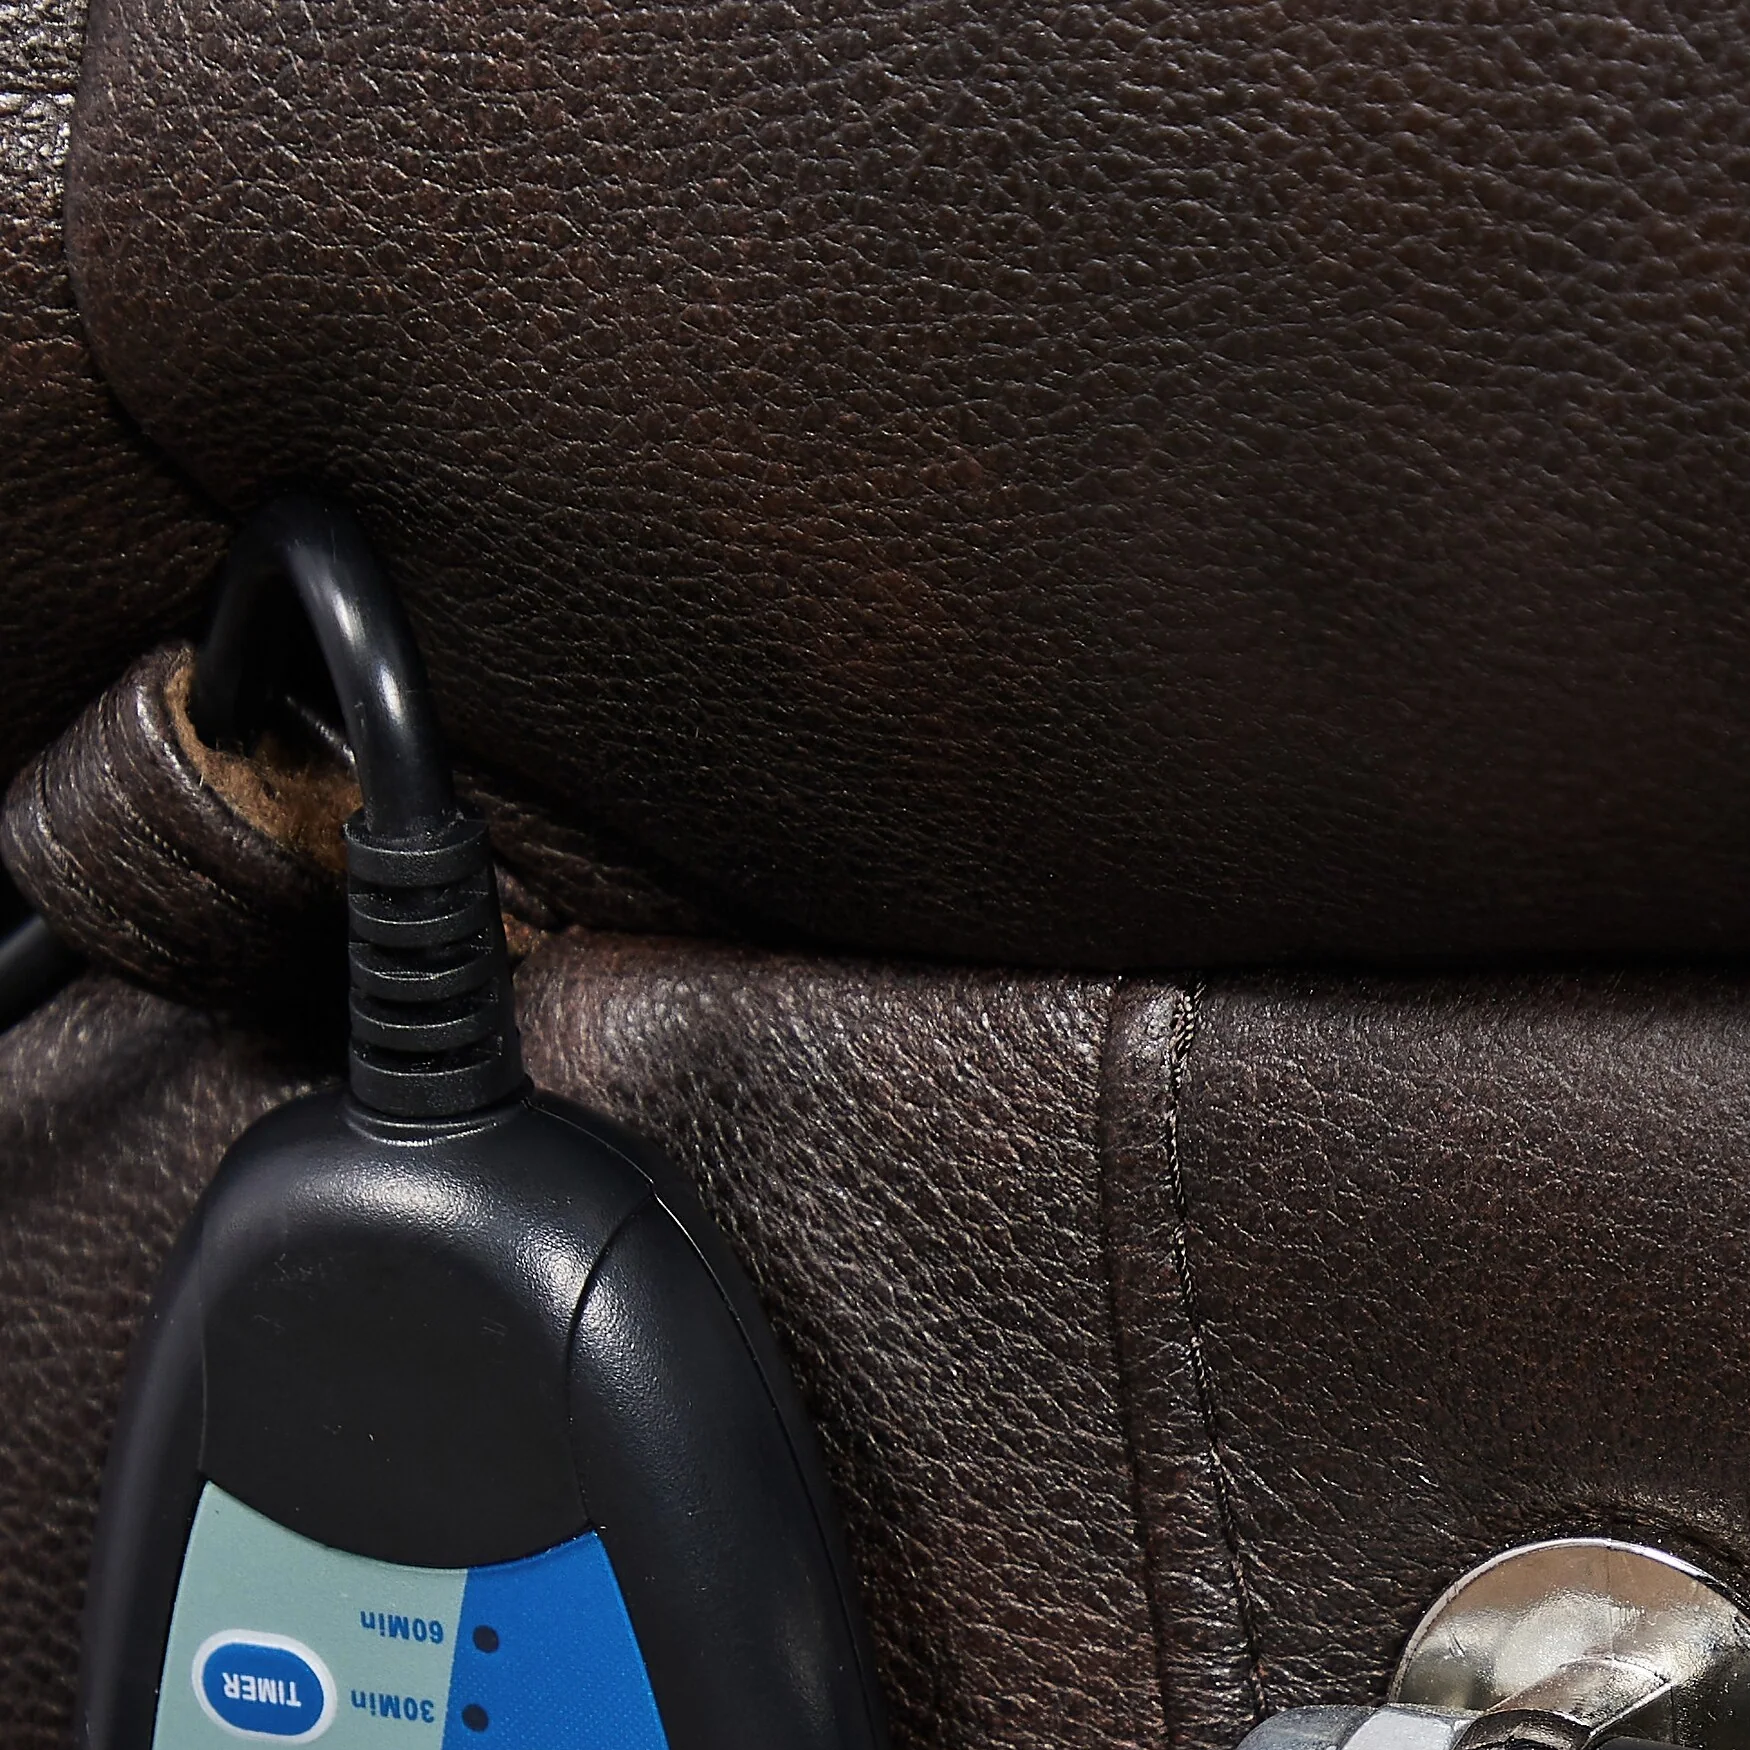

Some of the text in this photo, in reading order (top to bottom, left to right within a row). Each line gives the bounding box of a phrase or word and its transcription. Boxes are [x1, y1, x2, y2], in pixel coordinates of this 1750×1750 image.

[360, 1610, 444, 1644] 60Min
[221, 1671, 302, 1708] TIMER
[350, 1688, 435, 1723] 30Min
